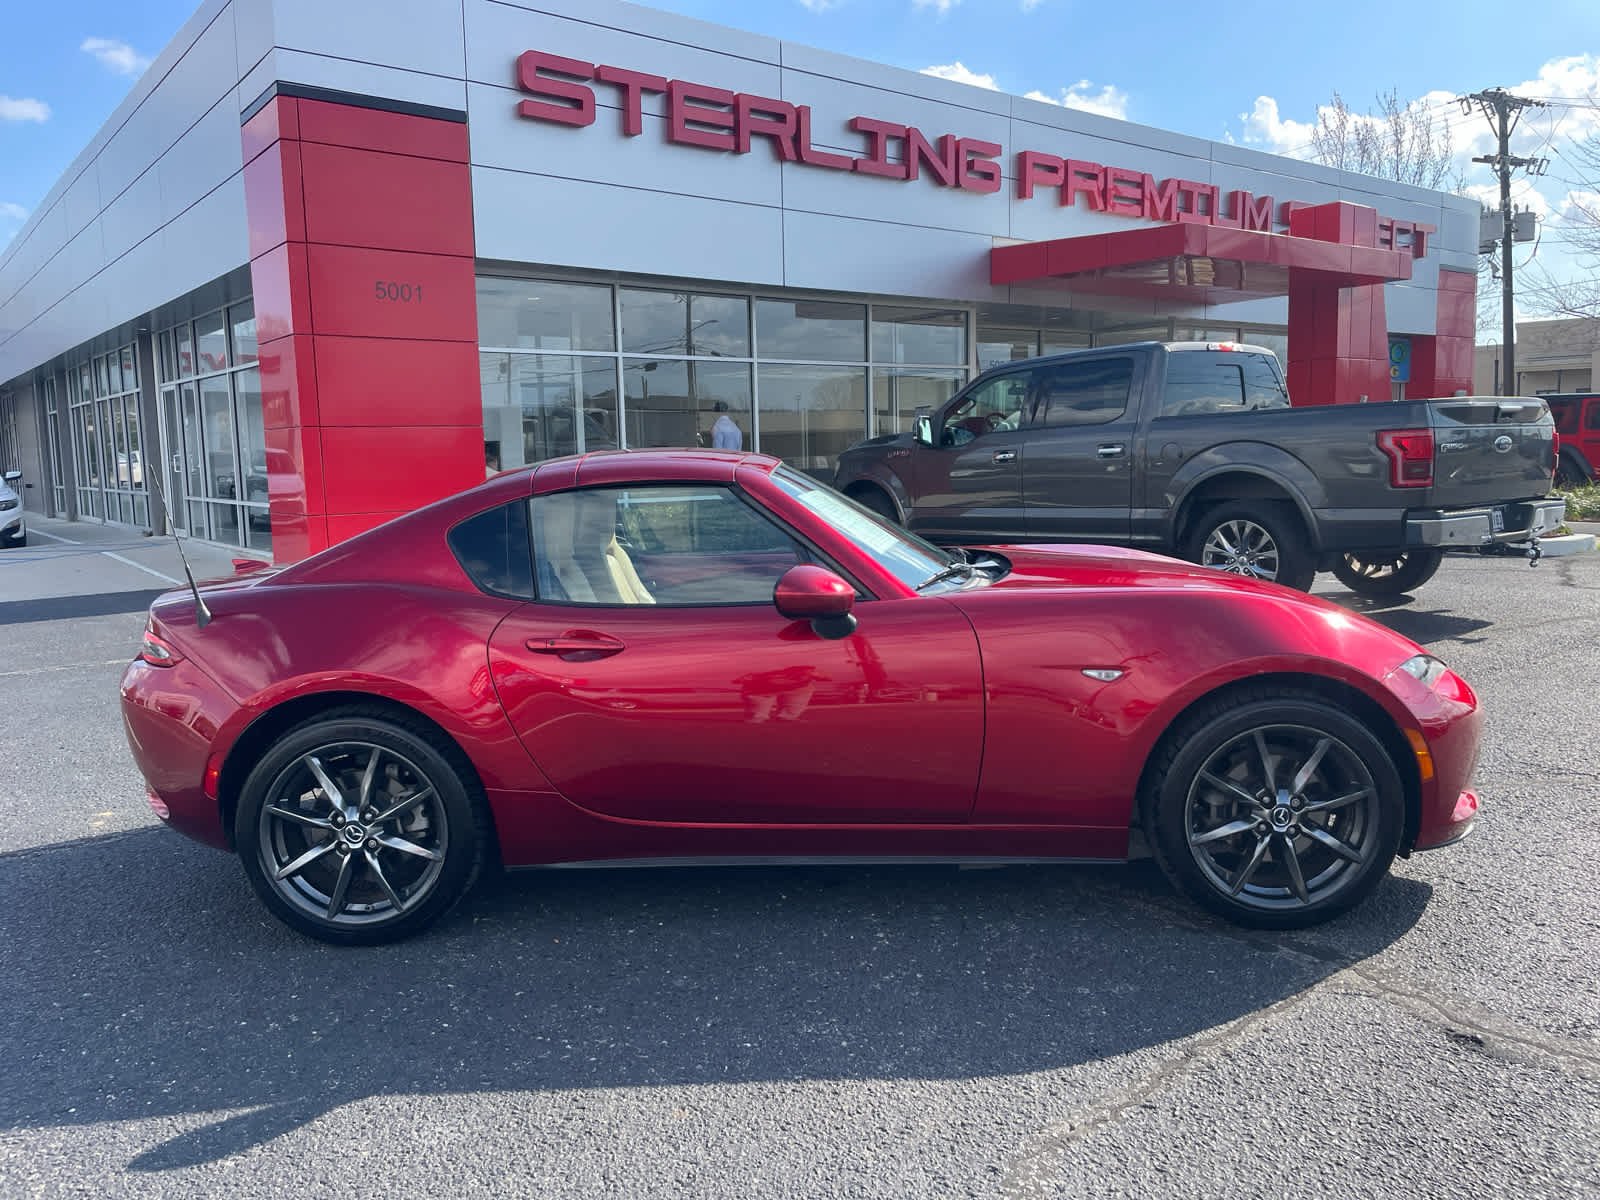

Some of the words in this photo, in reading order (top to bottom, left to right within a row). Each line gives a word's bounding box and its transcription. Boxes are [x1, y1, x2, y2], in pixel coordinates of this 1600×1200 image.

[517, 49, 1002, 193] STERLING
[1017, 151, 1274, 233] PREMIUM
[375, 280, 422, 304] 5001
